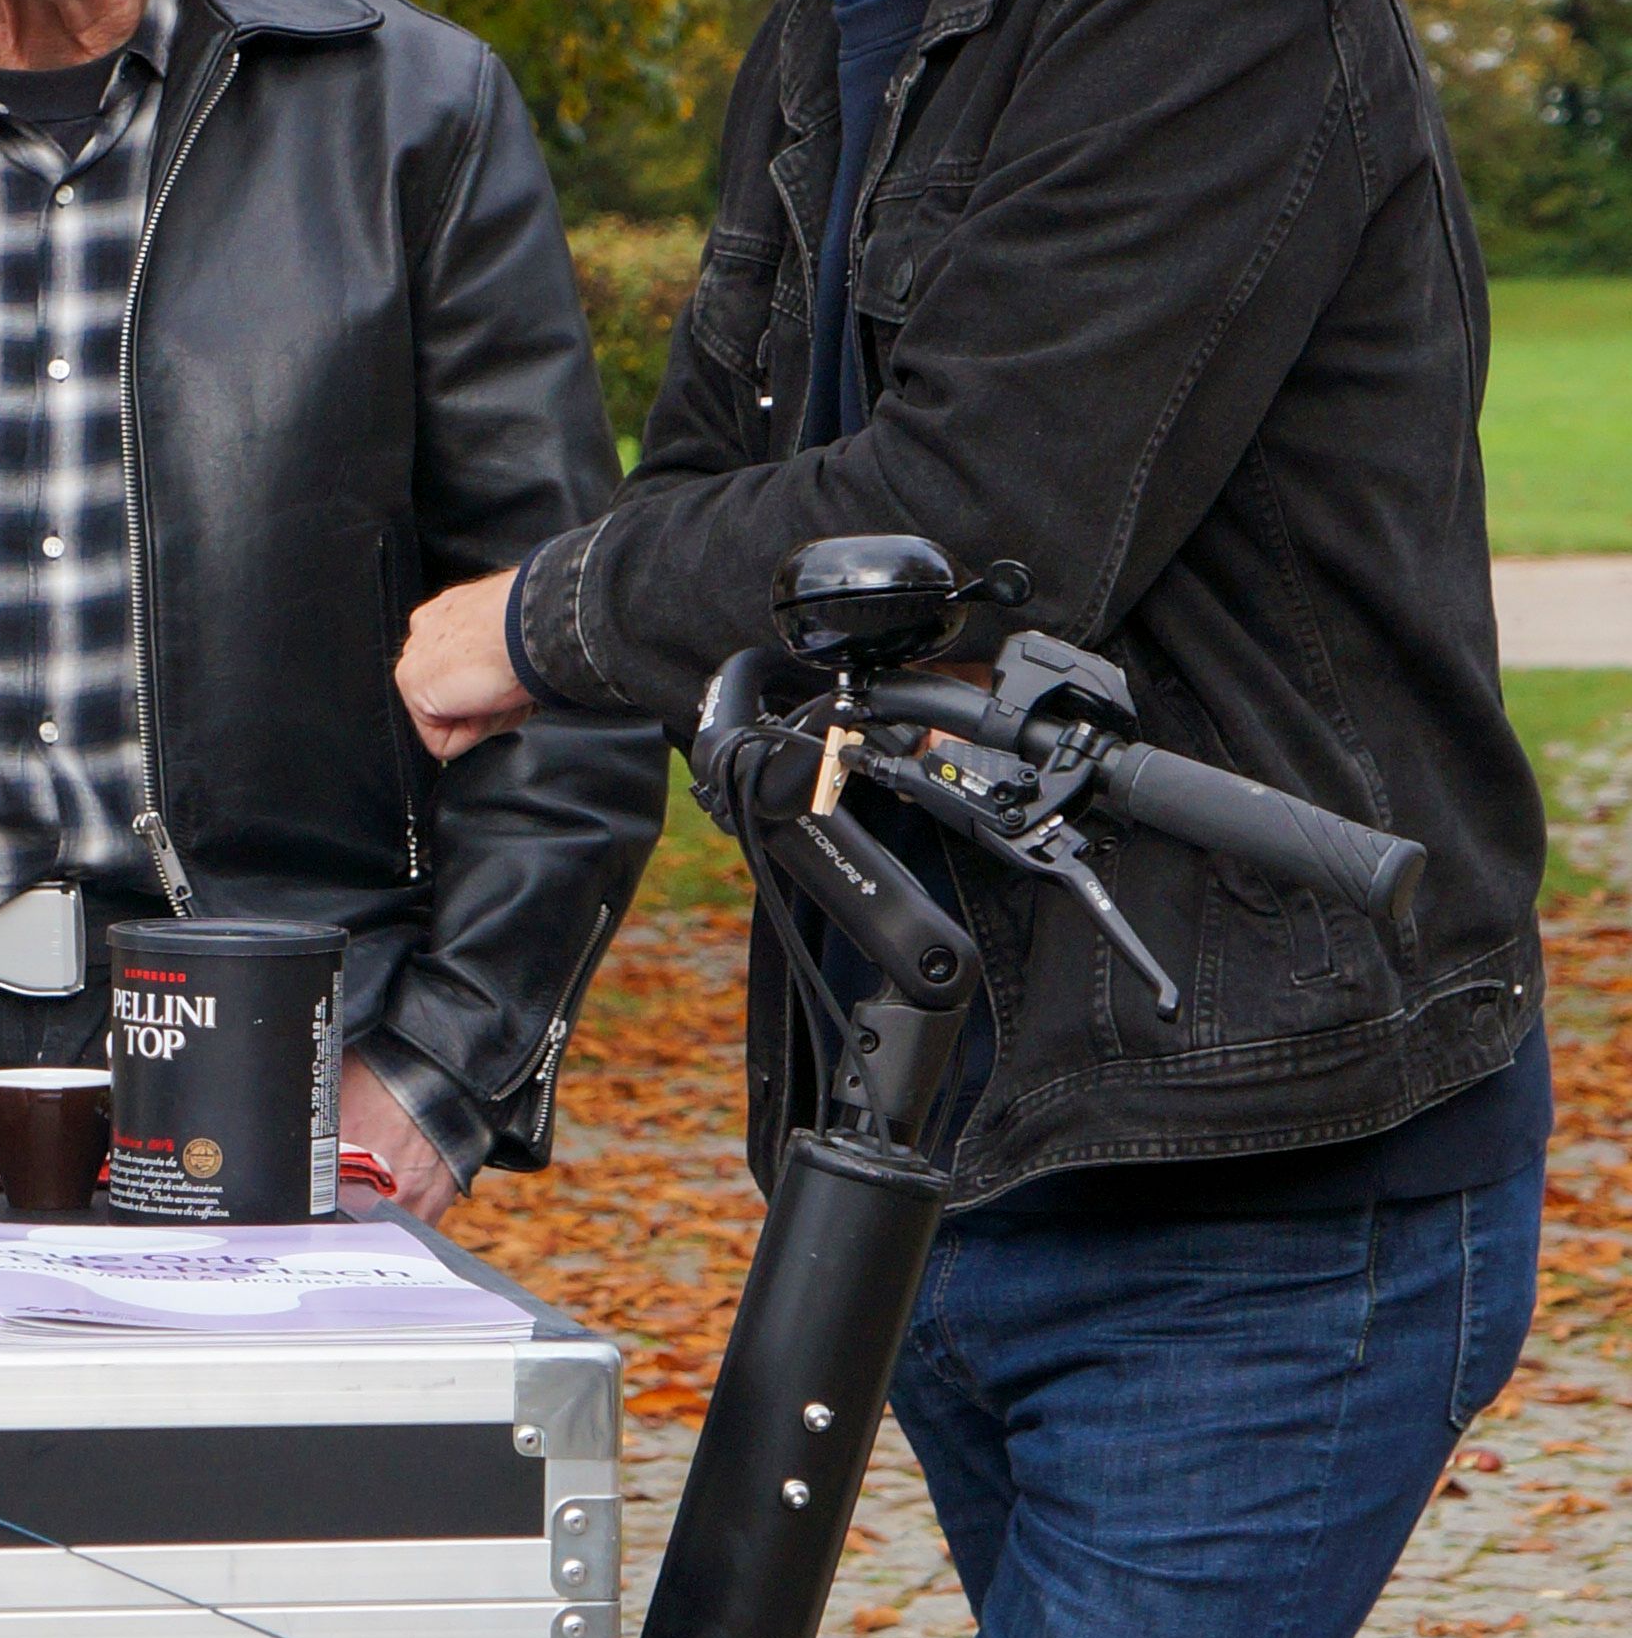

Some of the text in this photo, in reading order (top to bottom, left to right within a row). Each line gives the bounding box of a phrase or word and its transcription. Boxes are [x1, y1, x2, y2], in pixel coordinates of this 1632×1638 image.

[113, 987, 217, 1029] PELLINI
[123, 1024, 186, 1061] TOP
[41, 1258, 411, 1278] Neuperlach
[142, 1254, 279, 1265] Orte
